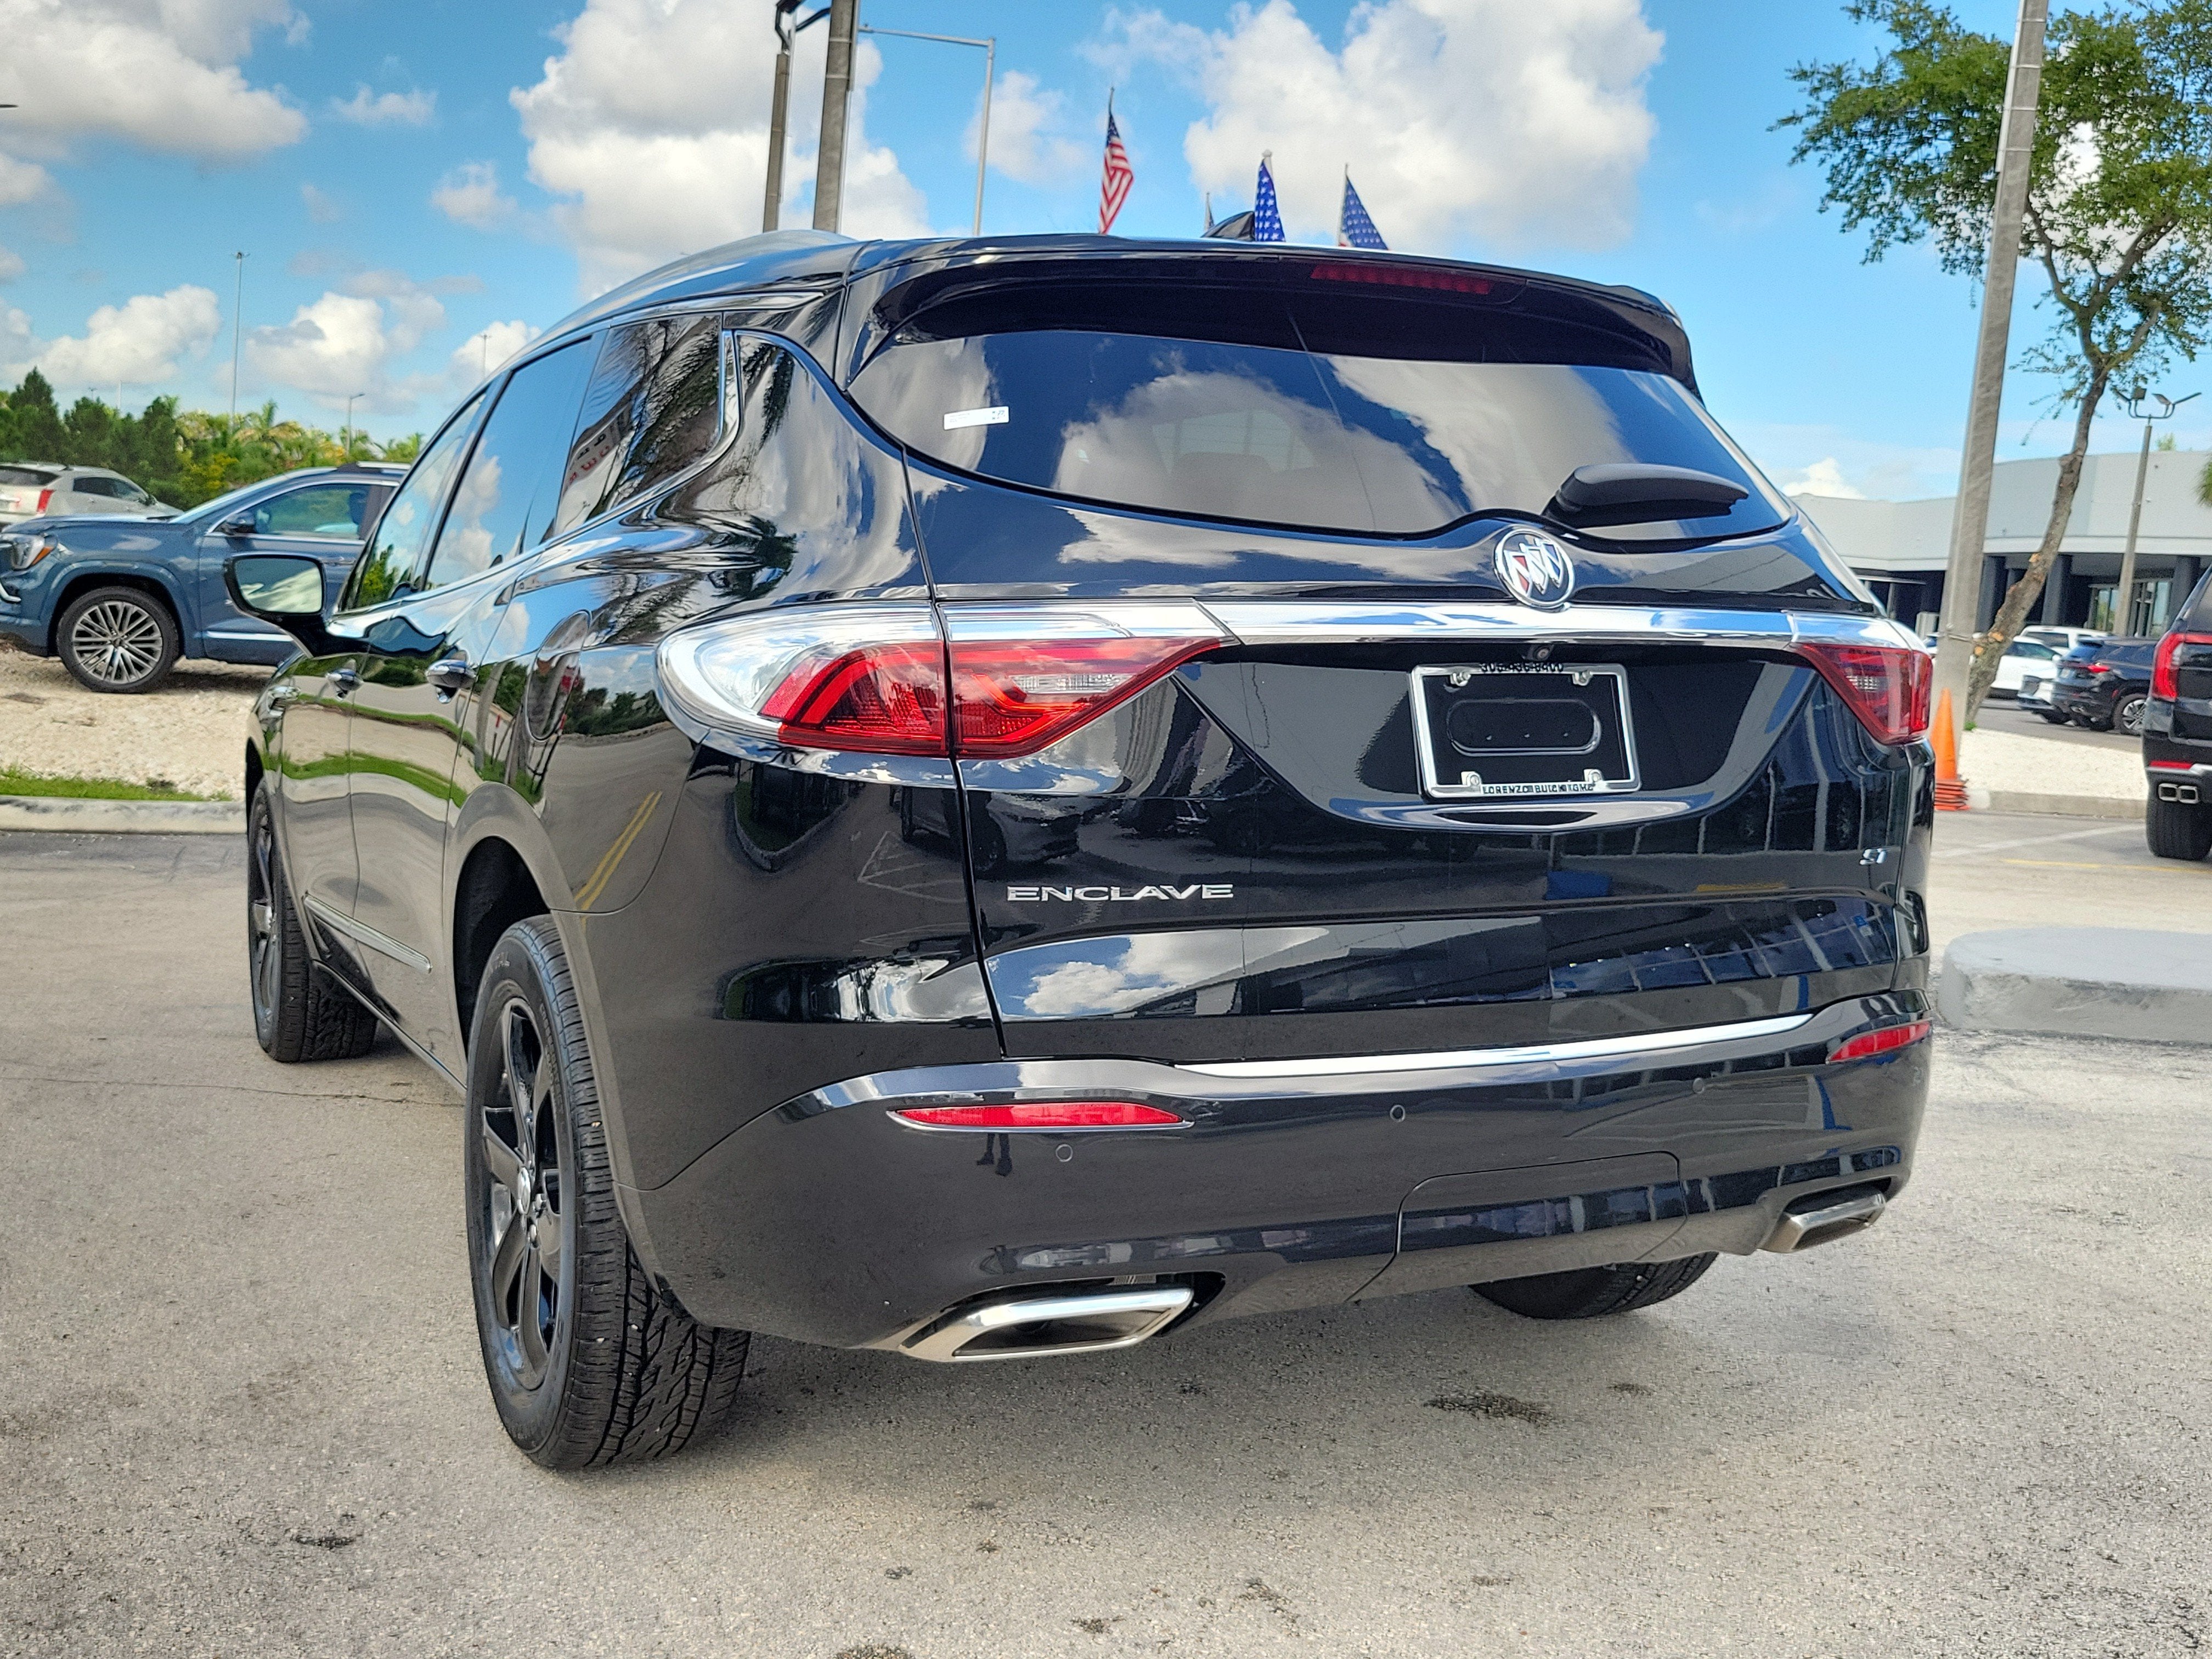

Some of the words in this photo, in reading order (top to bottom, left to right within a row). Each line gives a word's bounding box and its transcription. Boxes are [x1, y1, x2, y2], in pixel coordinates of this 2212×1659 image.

[1482, 785, 1529, 794] LORENZO
[1534, 784, 1566, 793] BUICK
[1007, 884, 1234, 901] ENCLAVE
